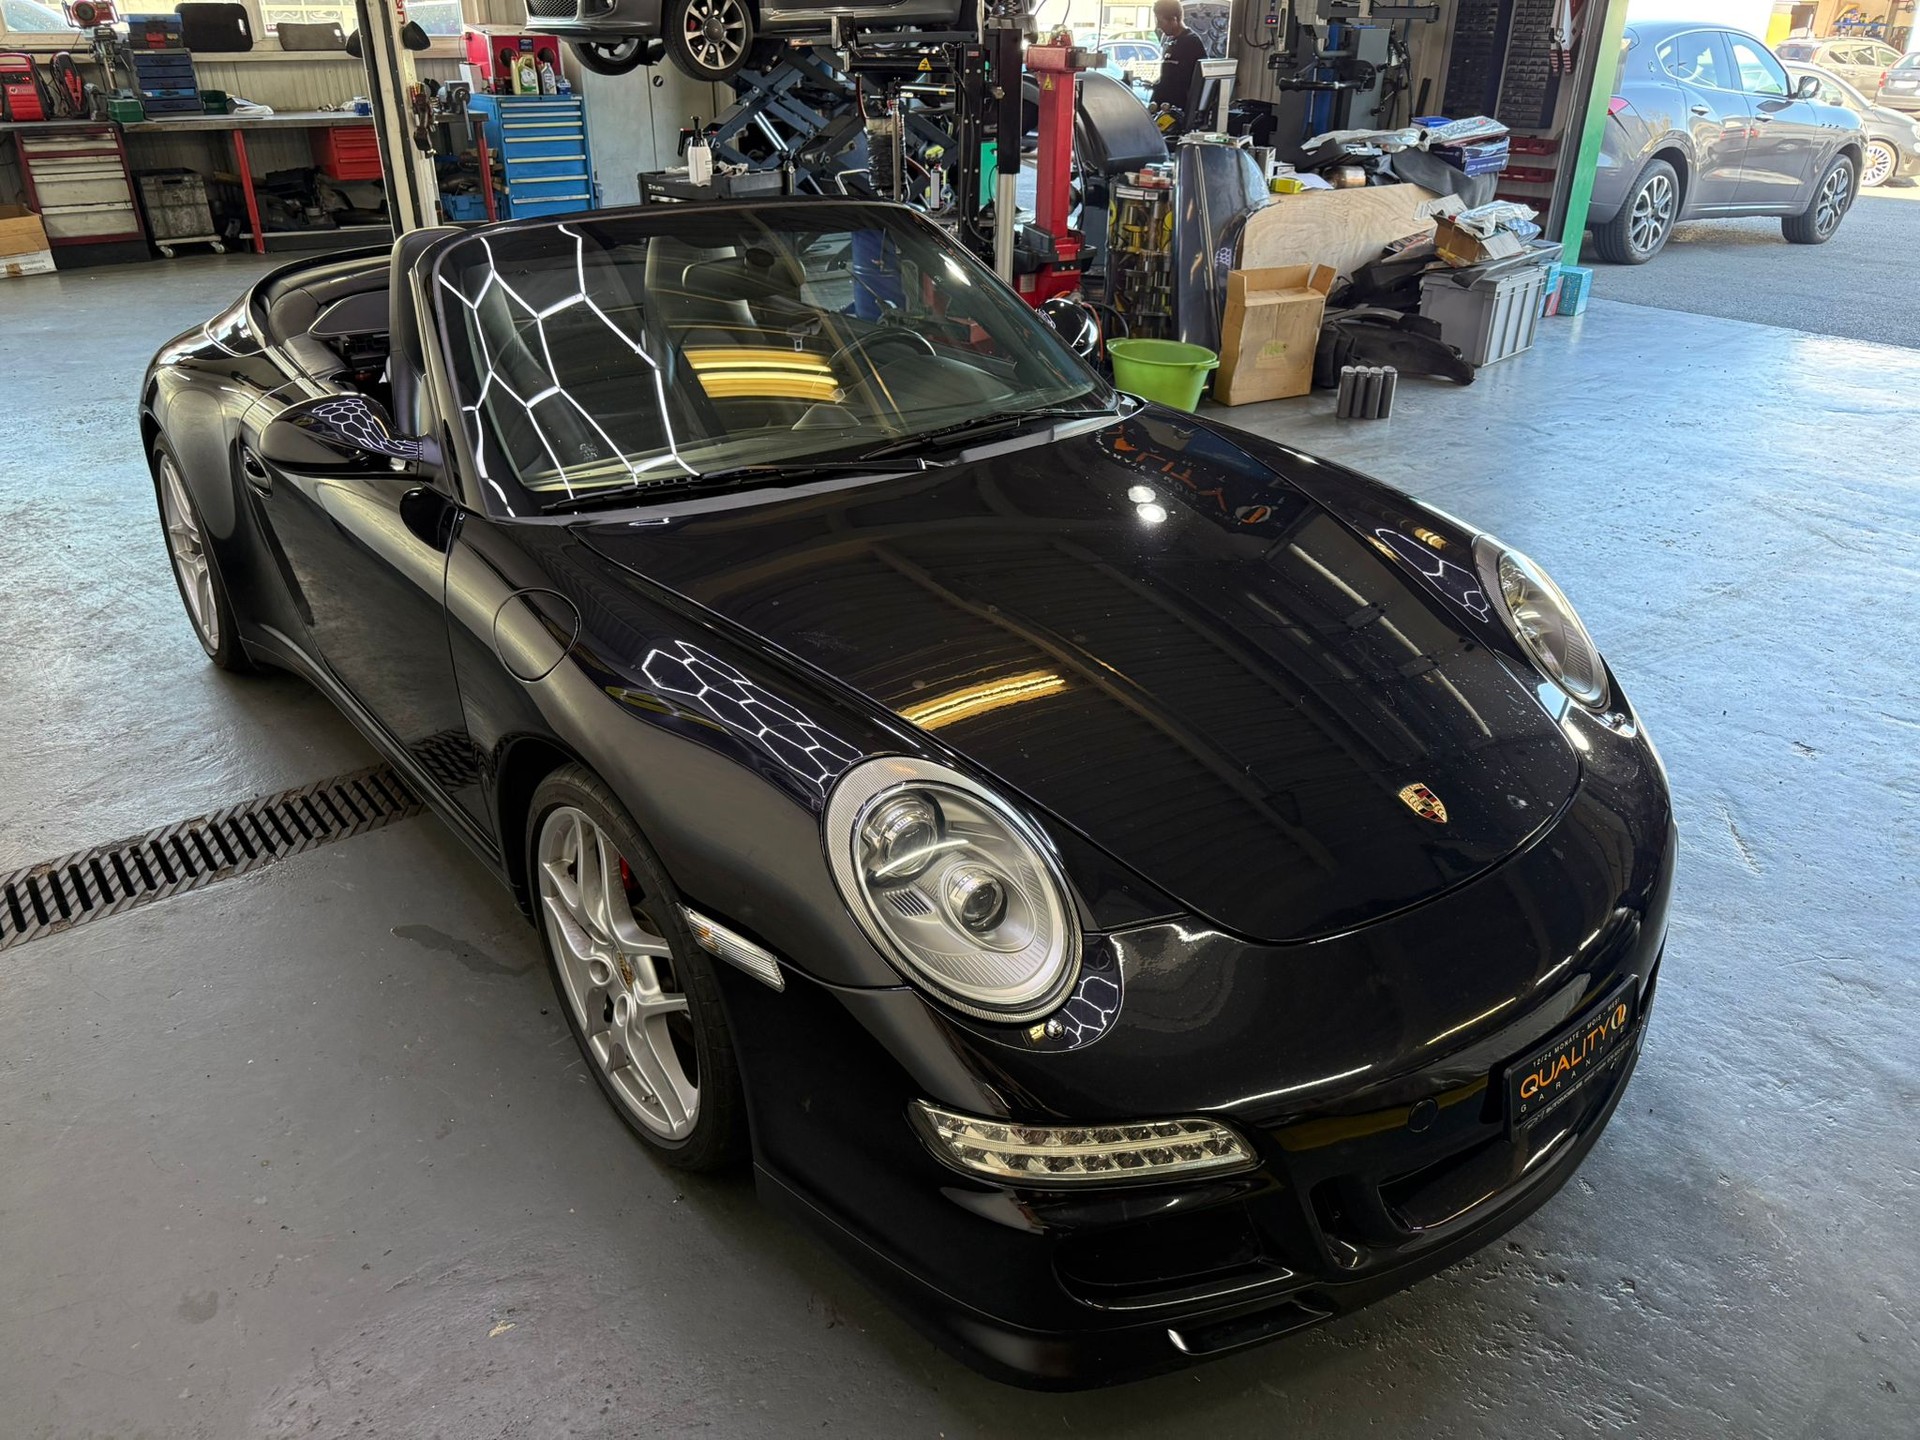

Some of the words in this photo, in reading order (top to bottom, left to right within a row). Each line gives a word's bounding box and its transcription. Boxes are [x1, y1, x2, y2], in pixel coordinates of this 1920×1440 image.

[1520, 1025, 1625, 1113] GARANTIE
[1533, 1051, 1552, 1067] 12/24
[1554, 1030, 1580, 1053] MONATE
[1587, 1013, 1602, 1030] MOIS
